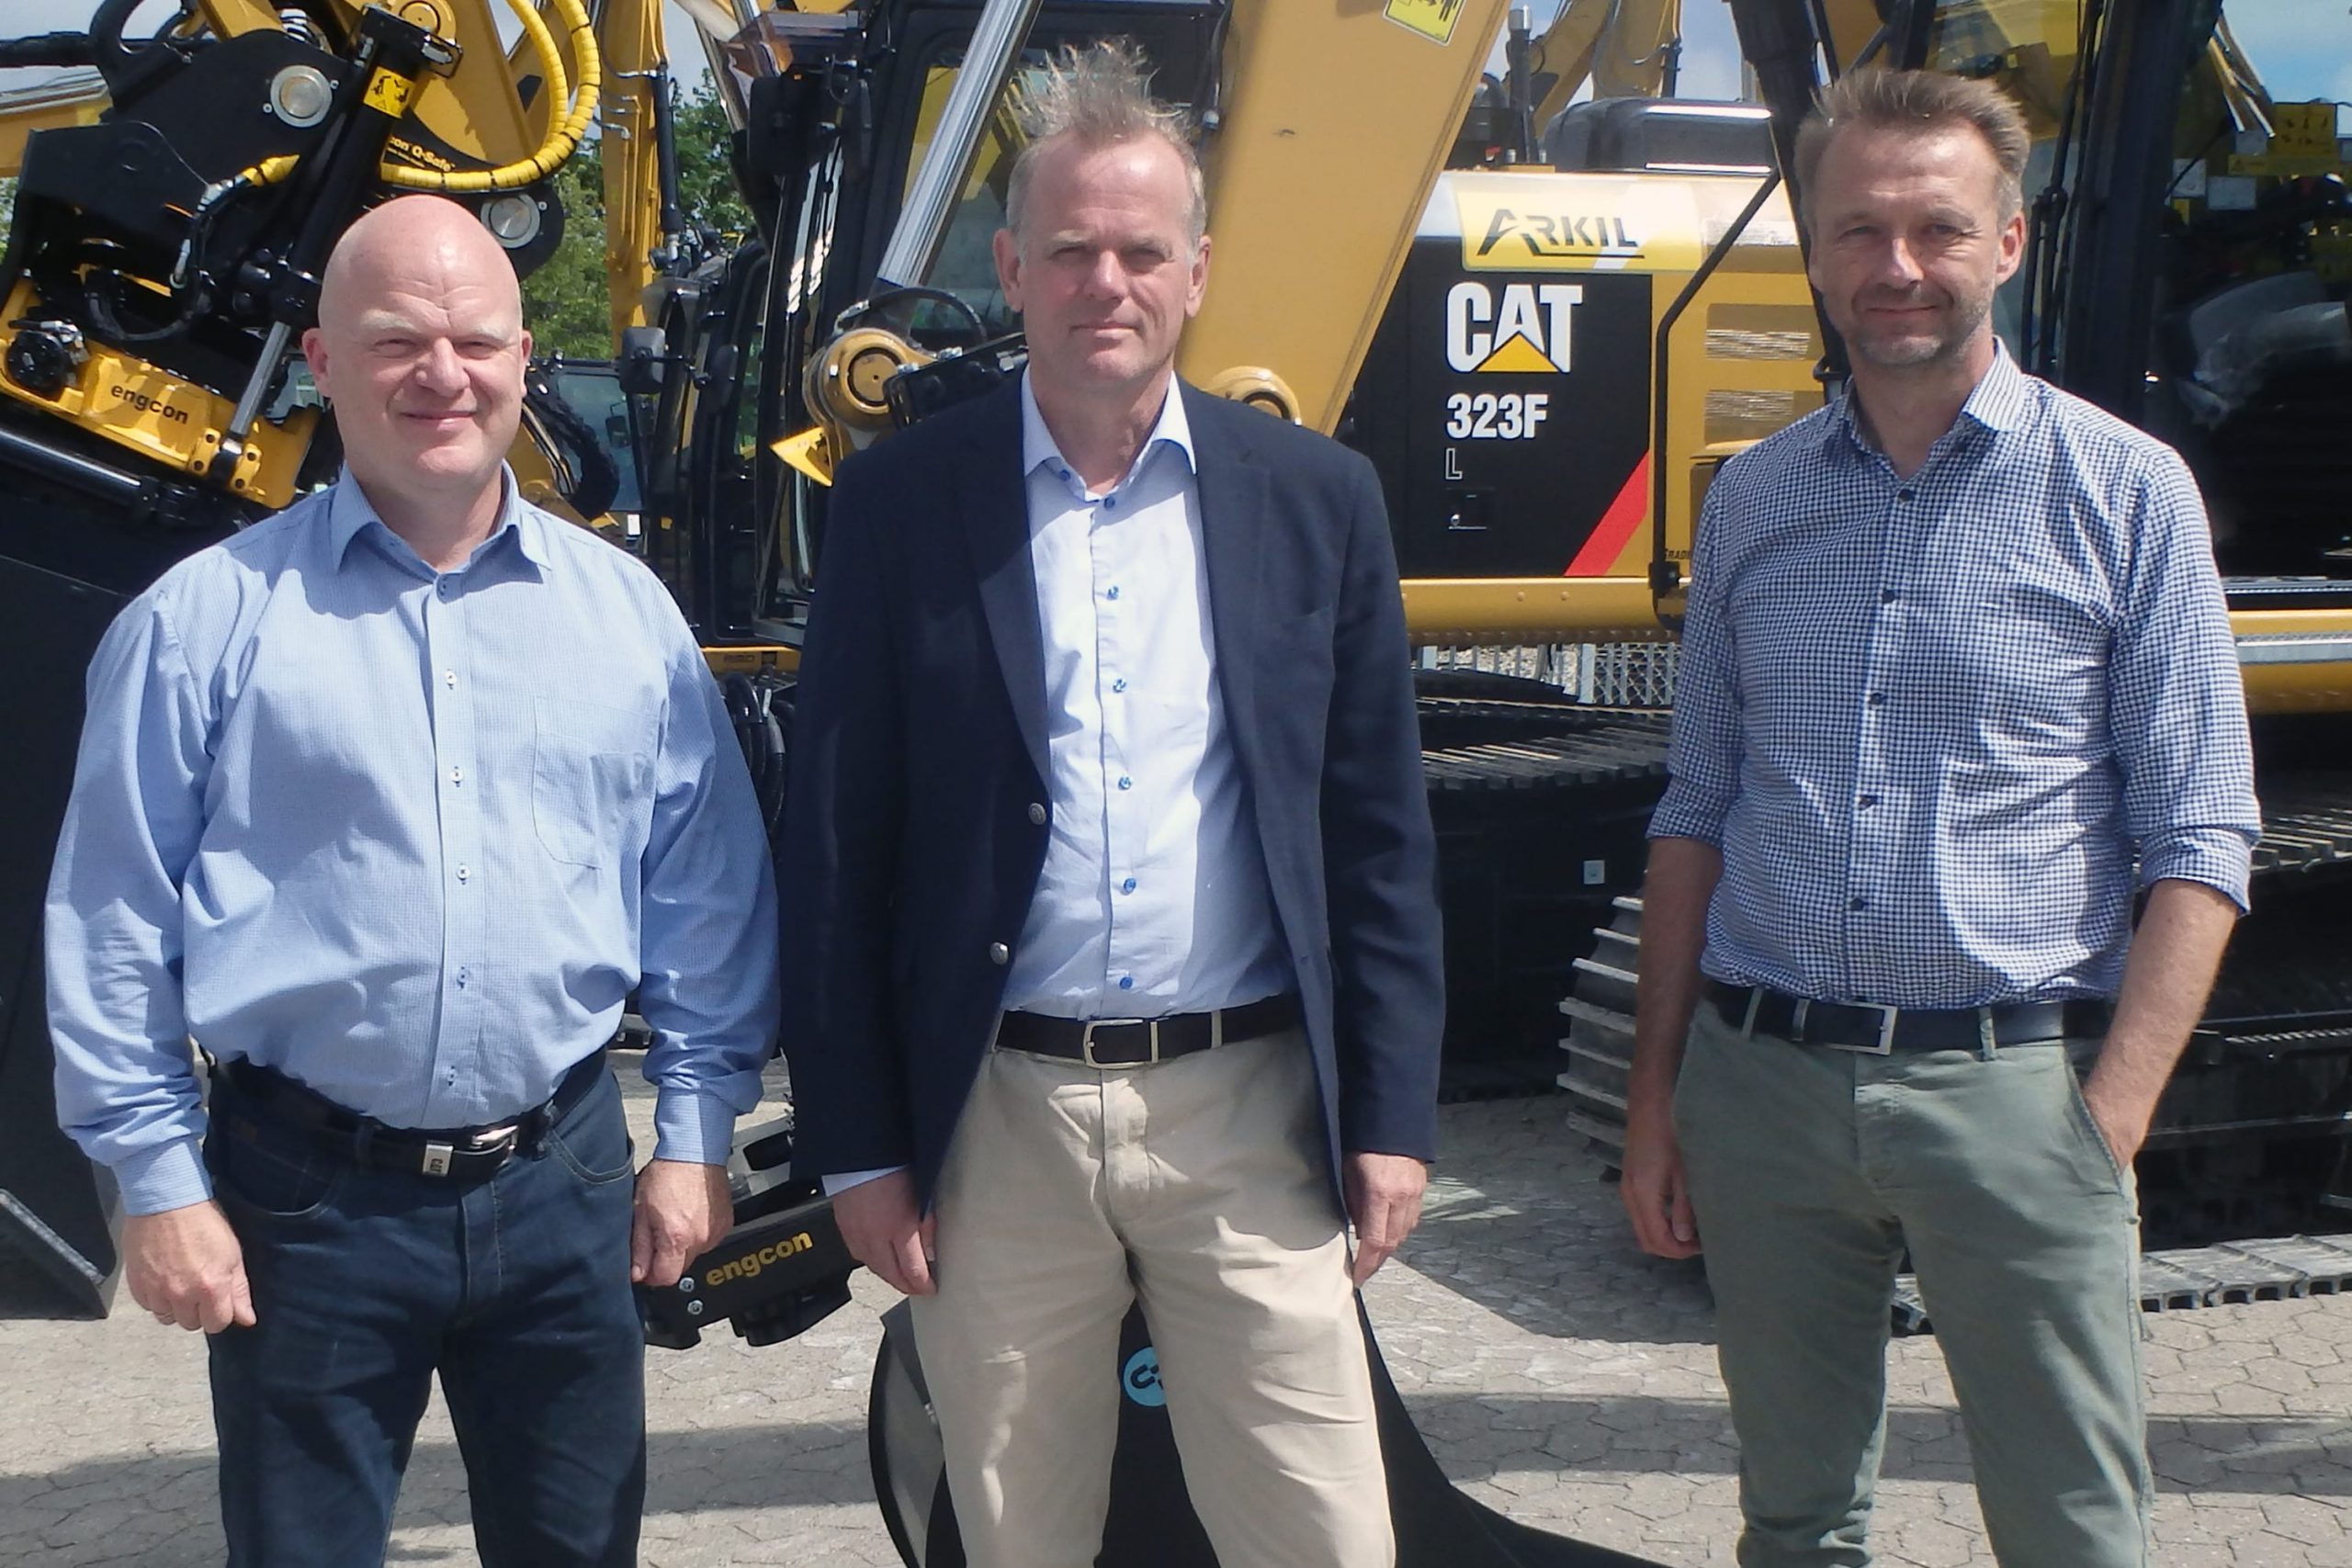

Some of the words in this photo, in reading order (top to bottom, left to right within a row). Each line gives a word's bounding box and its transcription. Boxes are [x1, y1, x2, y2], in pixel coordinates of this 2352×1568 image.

[1476, 208, 1645, 258] ARKIL
[1447, 281, 1583, 374] CAT
[110, 385, 188, 424] engcon
[1446, 392, 1549, 439] 323F
[1445, 447, 1463, 479] L
[706, 1232, 813, 1286] engcon
